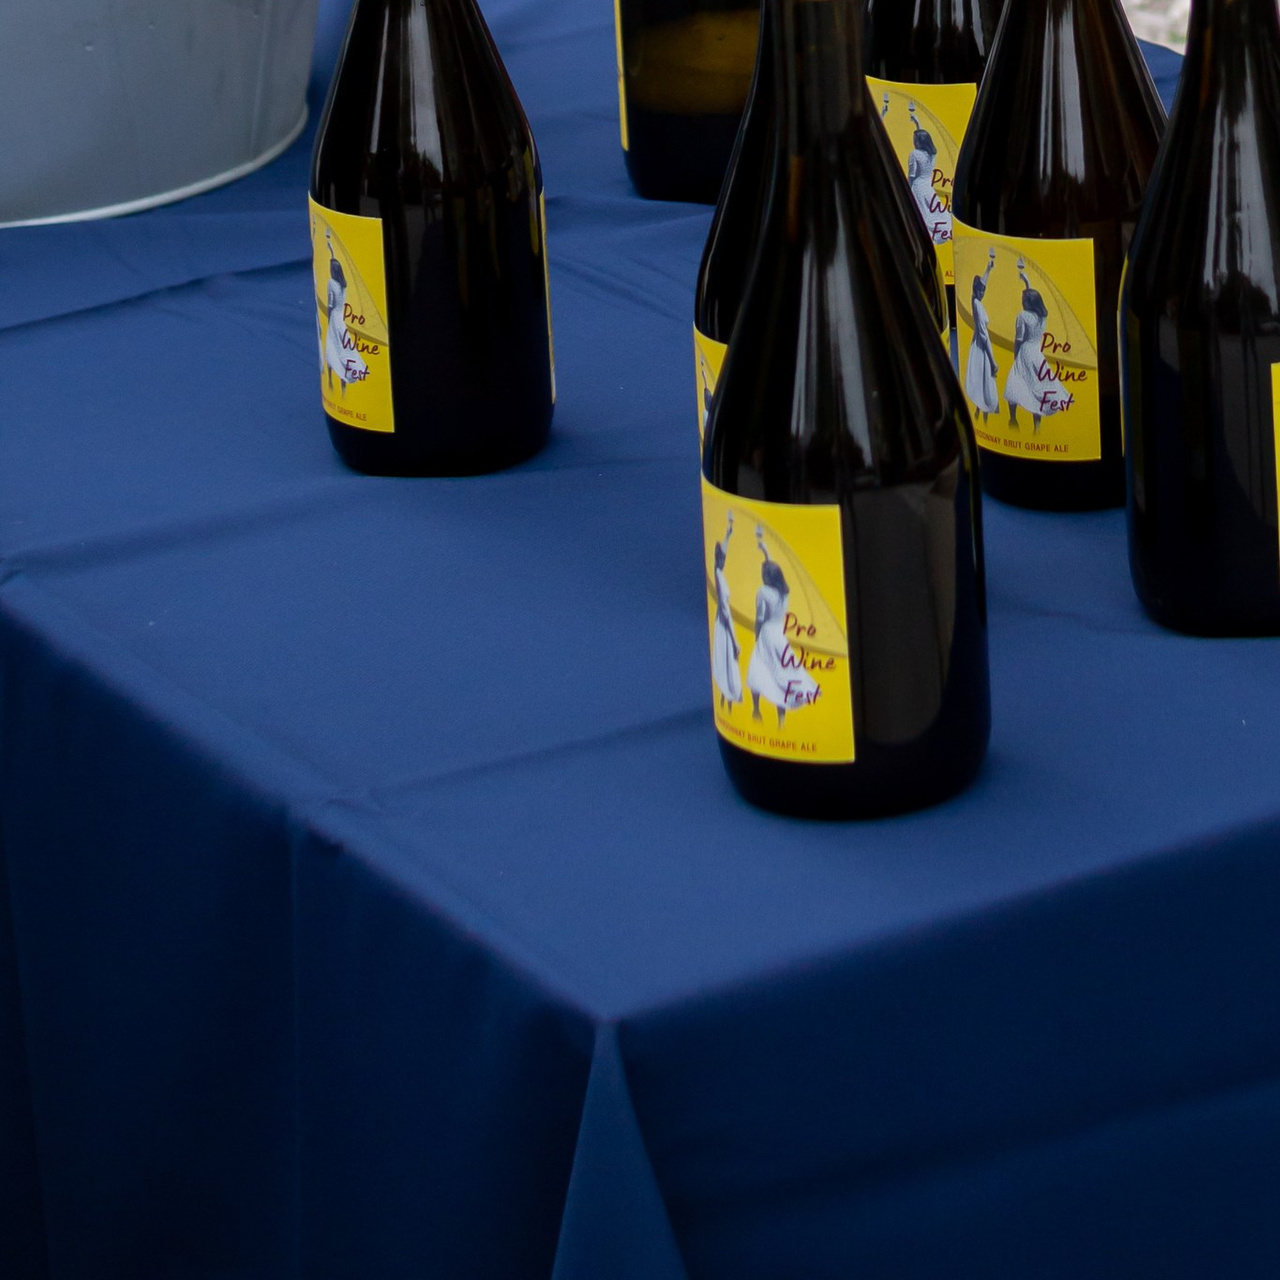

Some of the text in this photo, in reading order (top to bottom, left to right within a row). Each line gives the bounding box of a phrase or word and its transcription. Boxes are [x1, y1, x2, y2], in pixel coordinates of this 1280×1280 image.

[929, 193, 953, 214] Wi
[343, 302, 365, 325] Pro
[340, 328, 380, 355] Wine
[1040, 331, 1071, 356] Pro
[344, 359, 370, 381] Fest
[1037, 357, 1087, 383] Wine
[1039, 389, 1075, 413] Fest
[355, 412, 367, 421] ALE
[1003, 439, 1022, 450] BRUT
[1025, 441, 1051, 453] GRAPE
[1053, 444, 1069, 453] ALE
[783, 612, 816, 638] Pro
[780, 644, 836, 671] Wine
[783, 680, 823, 705] Fest
[748, 732, 766, 745] BRUT
[769, 737, 797, 751] GRAPE
[801, 742, 817, 752] ALE
